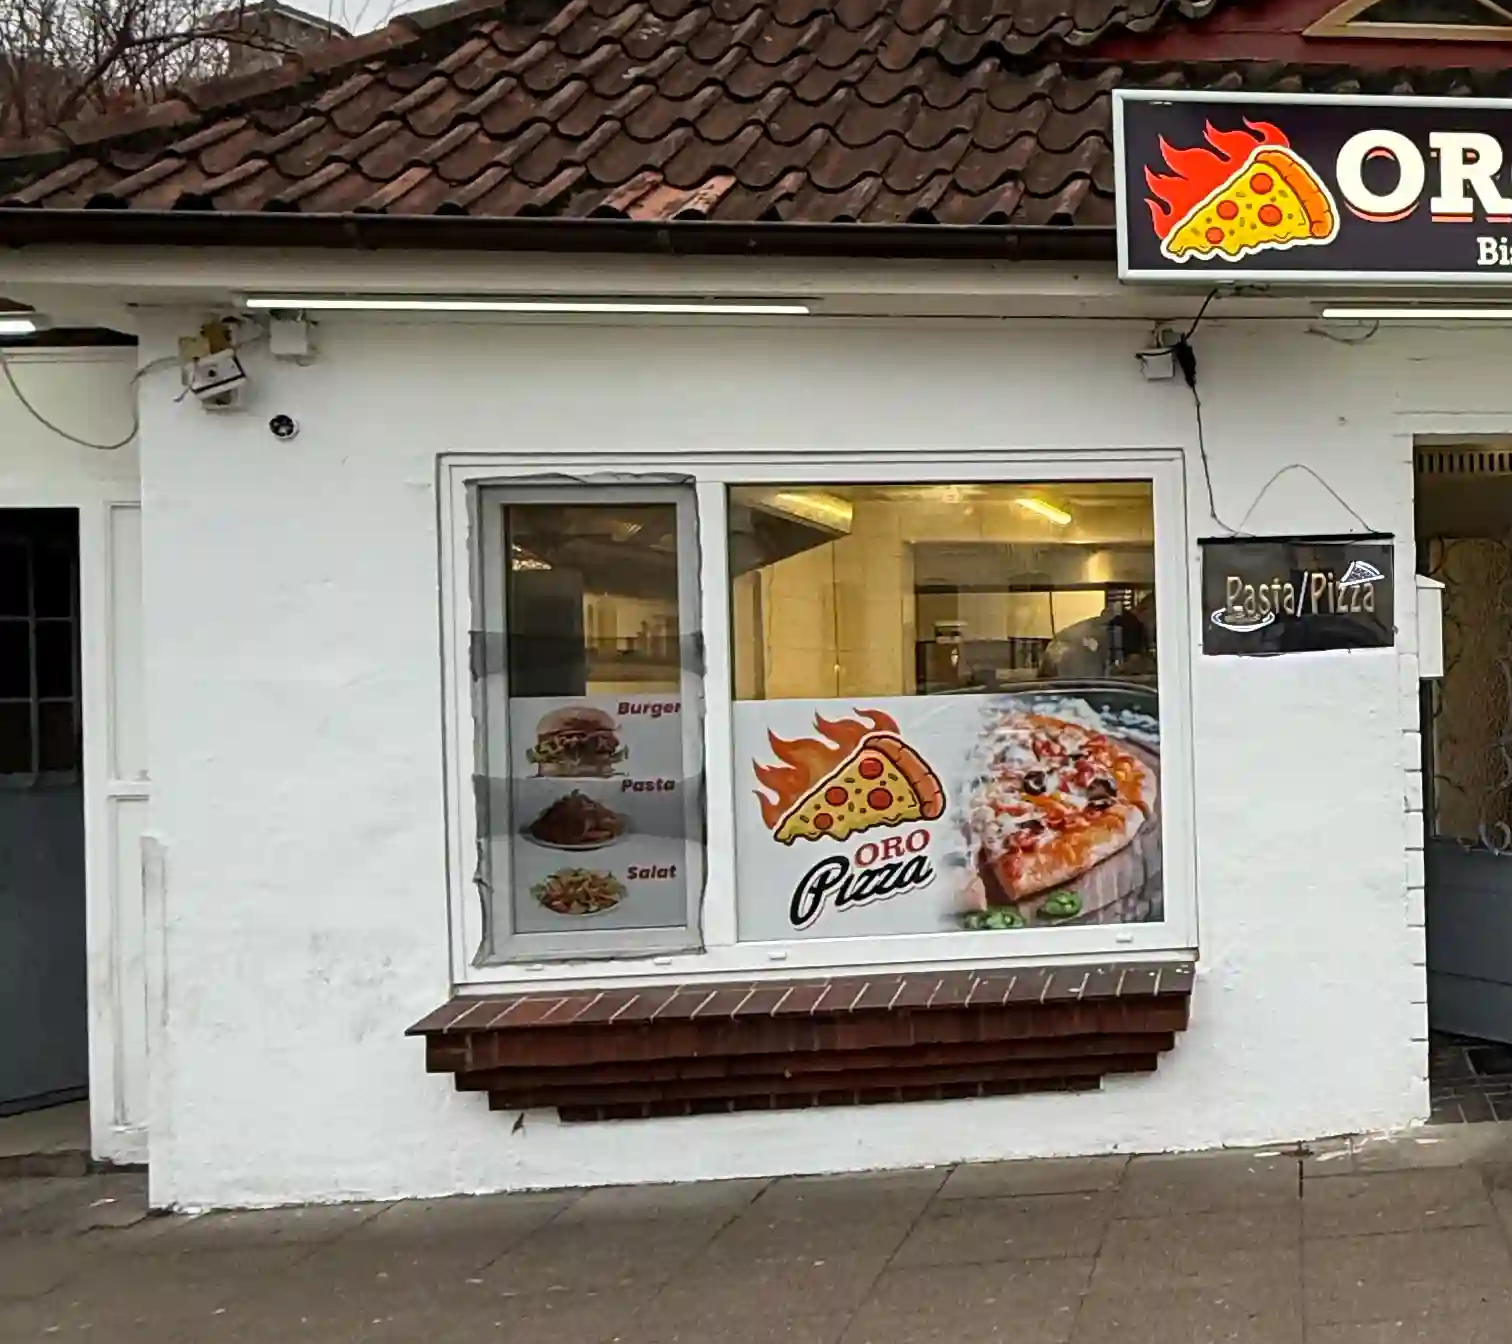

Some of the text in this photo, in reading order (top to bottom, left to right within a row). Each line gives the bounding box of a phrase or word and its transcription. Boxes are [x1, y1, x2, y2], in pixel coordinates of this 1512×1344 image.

[1226, 571, 1376, 617] Pasta/Pizza
[617, 702, 681, 717] Burger
[621, 778, 676, 792] Pasta
[854, 828, 931, 868] ORO
[627, 865, 677, 880] Salat
[789, 855, 934, 926] Pizza
